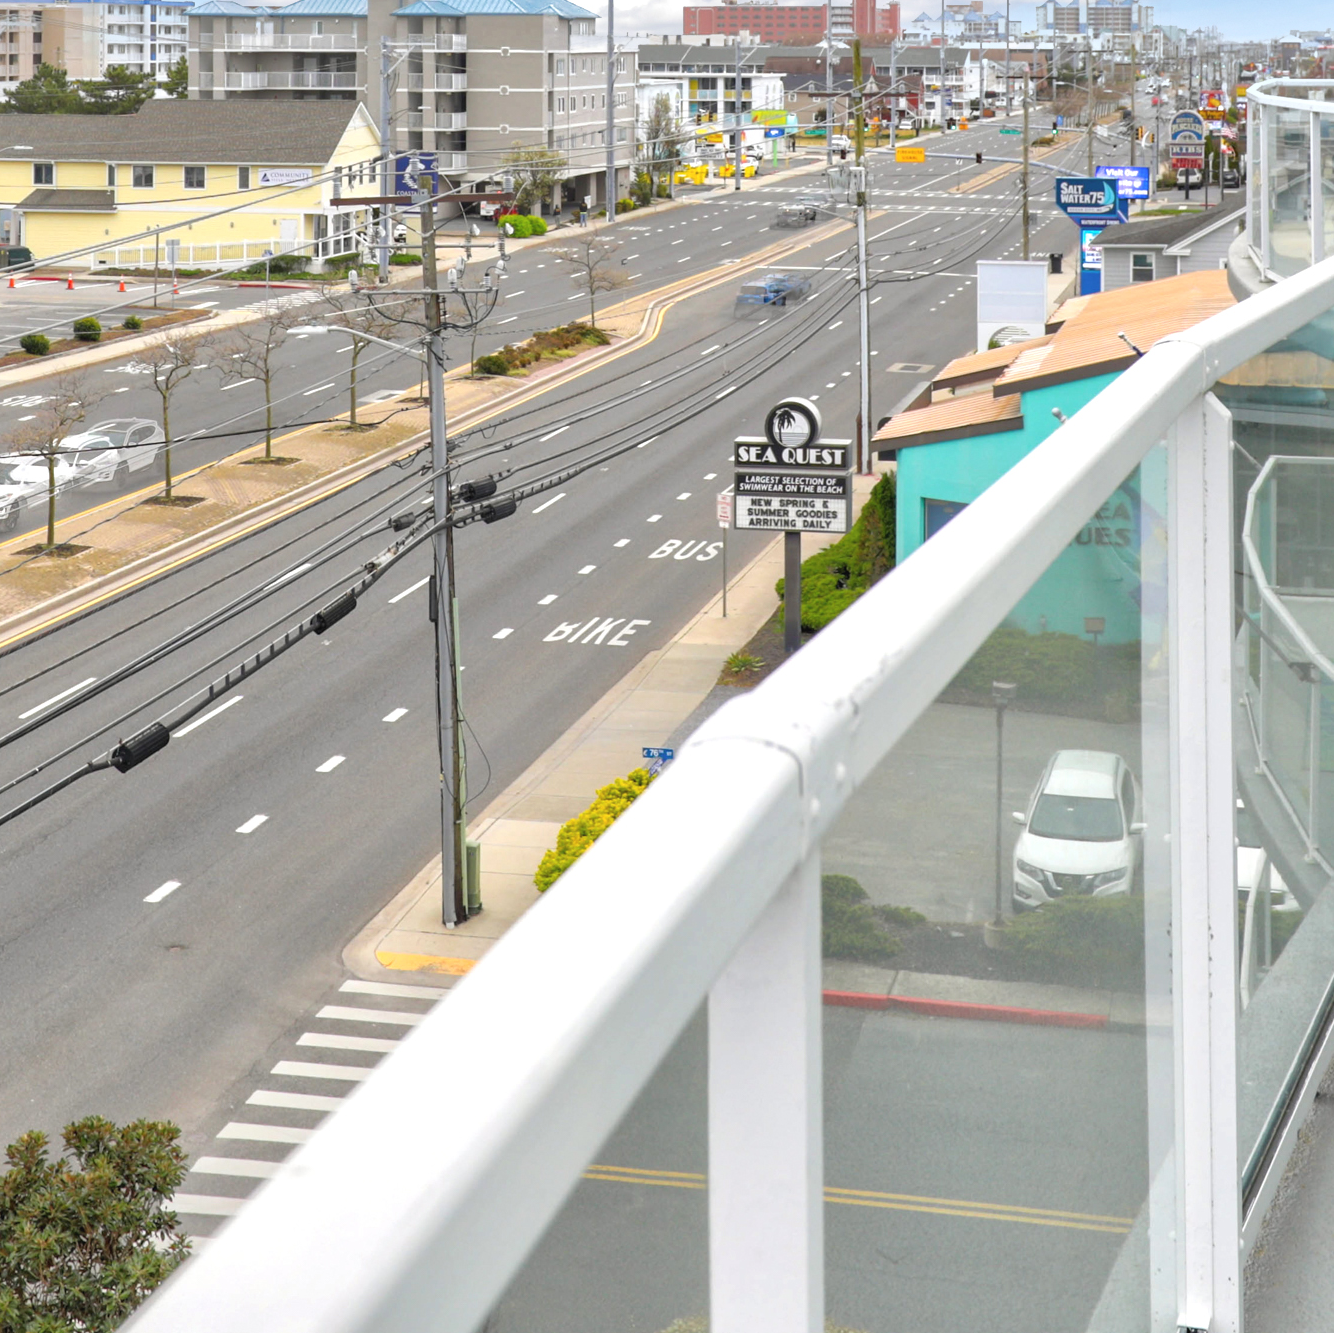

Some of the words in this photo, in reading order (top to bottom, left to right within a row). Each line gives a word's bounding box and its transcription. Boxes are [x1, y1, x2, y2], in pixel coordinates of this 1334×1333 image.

[1106, 168, 1123, 176] Visit
[1060, 182, 1083, 194] SALT
[738, 446, 777, 463] SEA
[782, 447, 845, 464] QUEST
[745, 475, 780, 484] LARGEST
[782, 476, 824, 485] SELECTION
[826, 478, 837, 486] OF
[739, 483, 784, 492] SWIMWEAR
[785, 484, 798, 493] ON
[799, 485, 815, 493] THE
[816, 486, 843, 494] BEACH
[750, 498, 772, 507] NEW
[779, 499, 815, 508] SPRING
[822, 500, 829, 509] &
[747, 508, 789, 517] SUMMER
[796, 510, 838, 519] GOODIES
[1094, 501, 1132, 521] EA
[748, 518, 796, 528] ARRIVING
[803, 520, 832, 528] DAILY
[648, 539, 724, 562] BUS
[542, 617, 652, 647] BIKE
